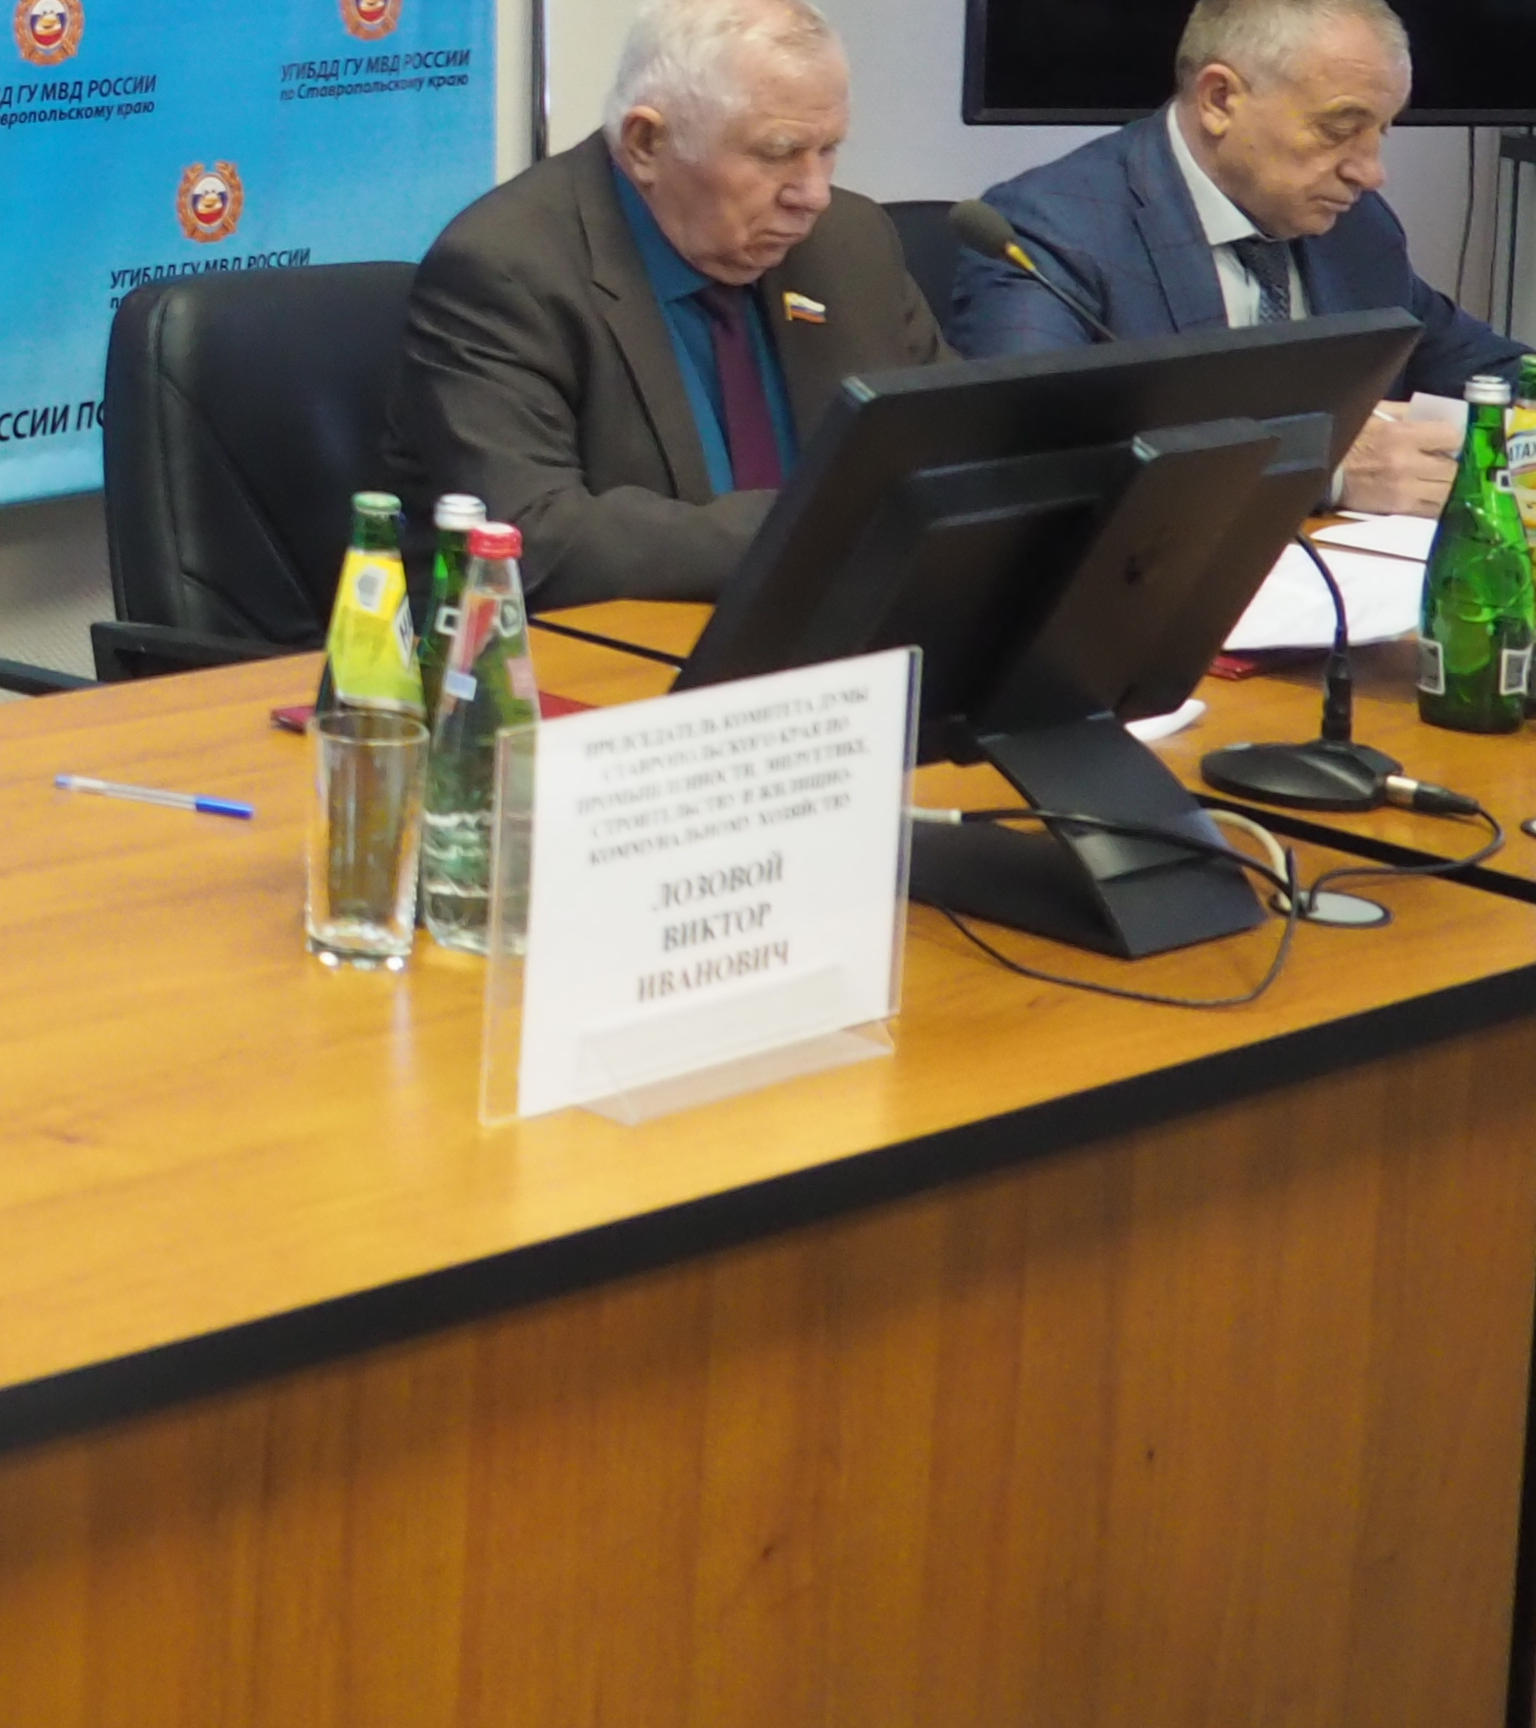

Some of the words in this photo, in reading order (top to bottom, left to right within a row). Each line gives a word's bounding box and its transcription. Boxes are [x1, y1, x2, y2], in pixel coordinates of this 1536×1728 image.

[281, 59, 339, 82] УГИБДД
[344, 58, 363, 75] ГУ
[366, 54, 400, 75] МВД
[405, 49, 470, 70] РОССИИ
[17, 84, 38, 104] ГУ
[41, 81, 83, 103] МВД
[87, 75, 157, 98] РОССИИ
[117, 101, 155, 119] краю
[247, 249, 311, 269] РОССИИ
[651, 849, 784, 913] ЛОЗОВОЙ
[661, 901, 773, 954] ВИКТОР
[636, 940, 791, 1004] ИВАНОВИЧ
